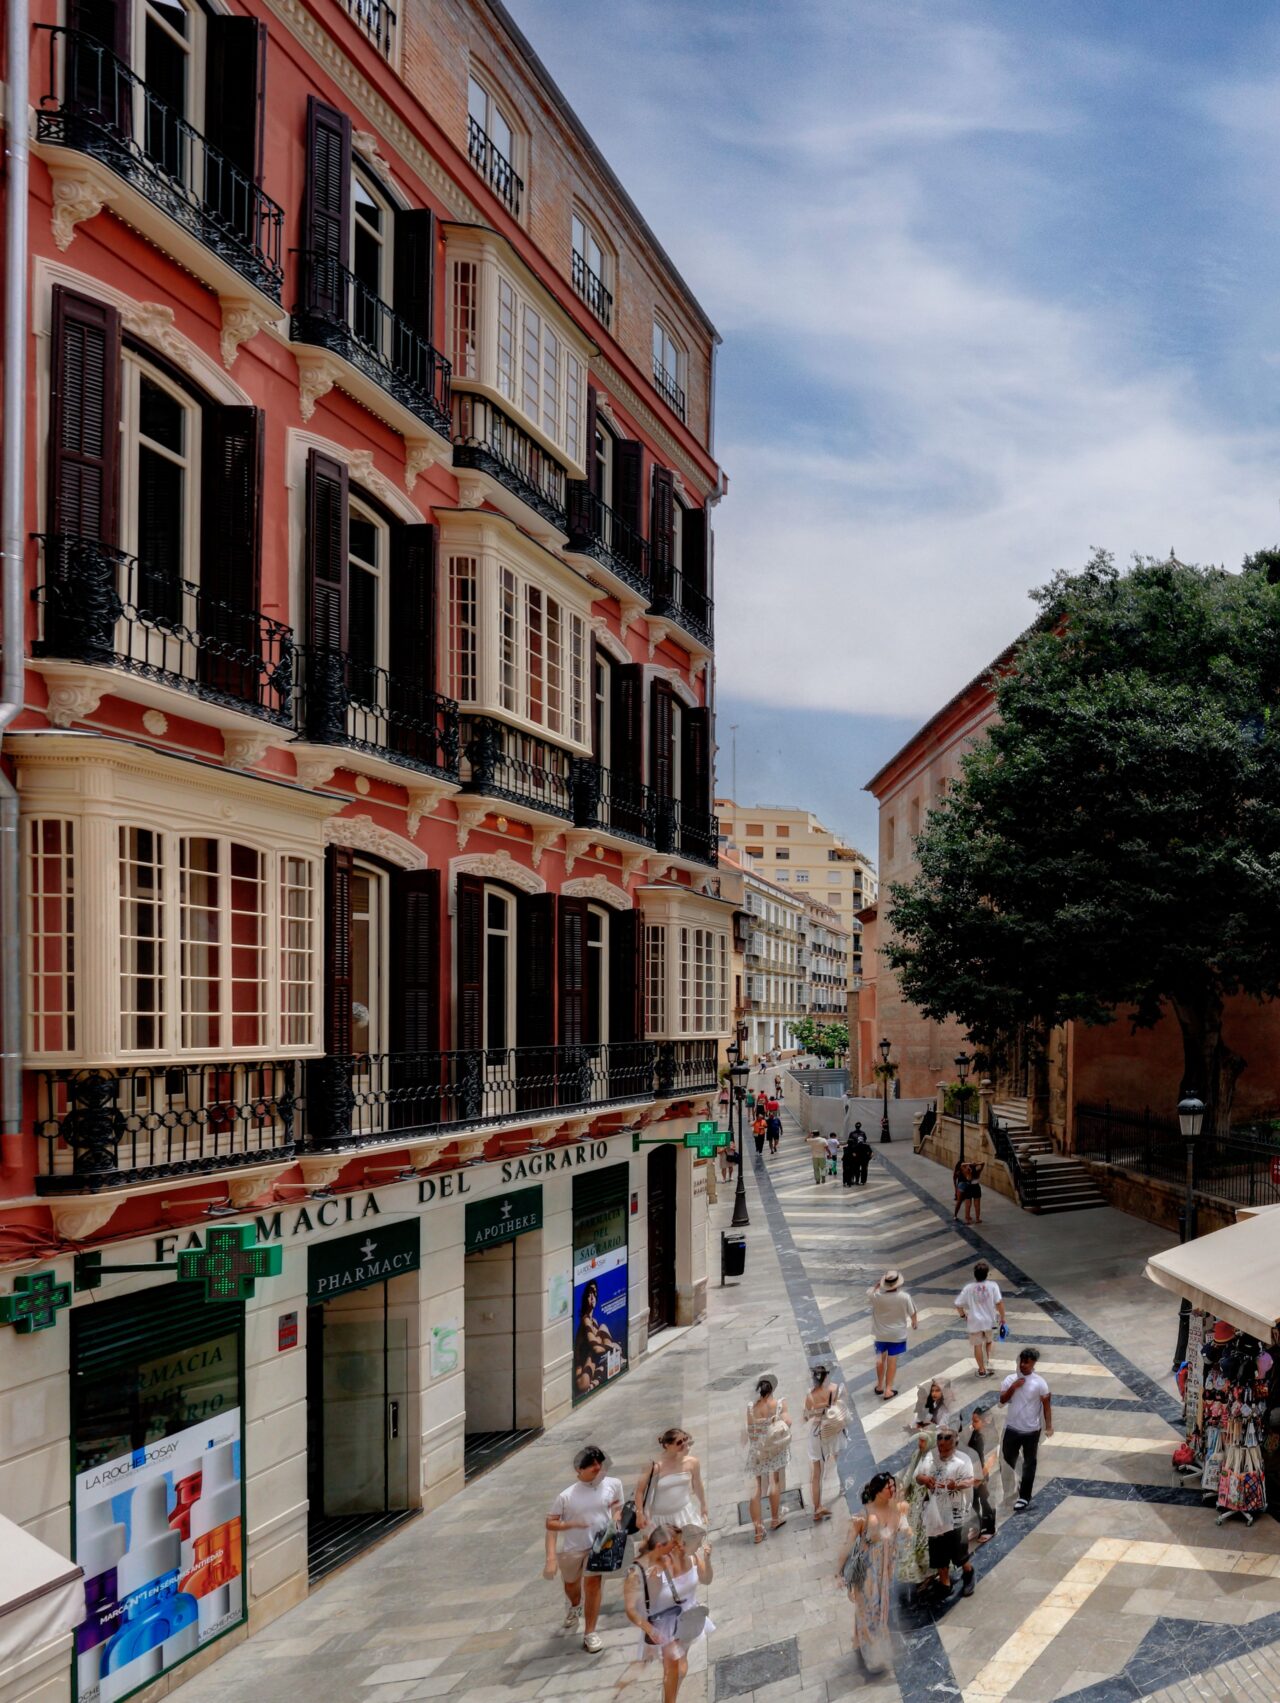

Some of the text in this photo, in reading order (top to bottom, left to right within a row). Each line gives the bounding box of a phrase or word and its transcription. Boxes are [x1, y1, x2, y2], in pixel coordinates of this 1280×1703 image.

[155, 1141, 608, 1262] FAMACIA DEL SAGRARIO
[474, 1213, 537, 1243] APOTHEKE
[317, 1251, 413, 1293] PHARMACY
[85, 1475, 101, 1490] LA
[102, 1456, 143, 1480] ROCHE
[144, 1440, 180, 1465] POSAY
[100, 1600, 130, 1625] MARCA
[148, 1587, 159, 1597] EN
